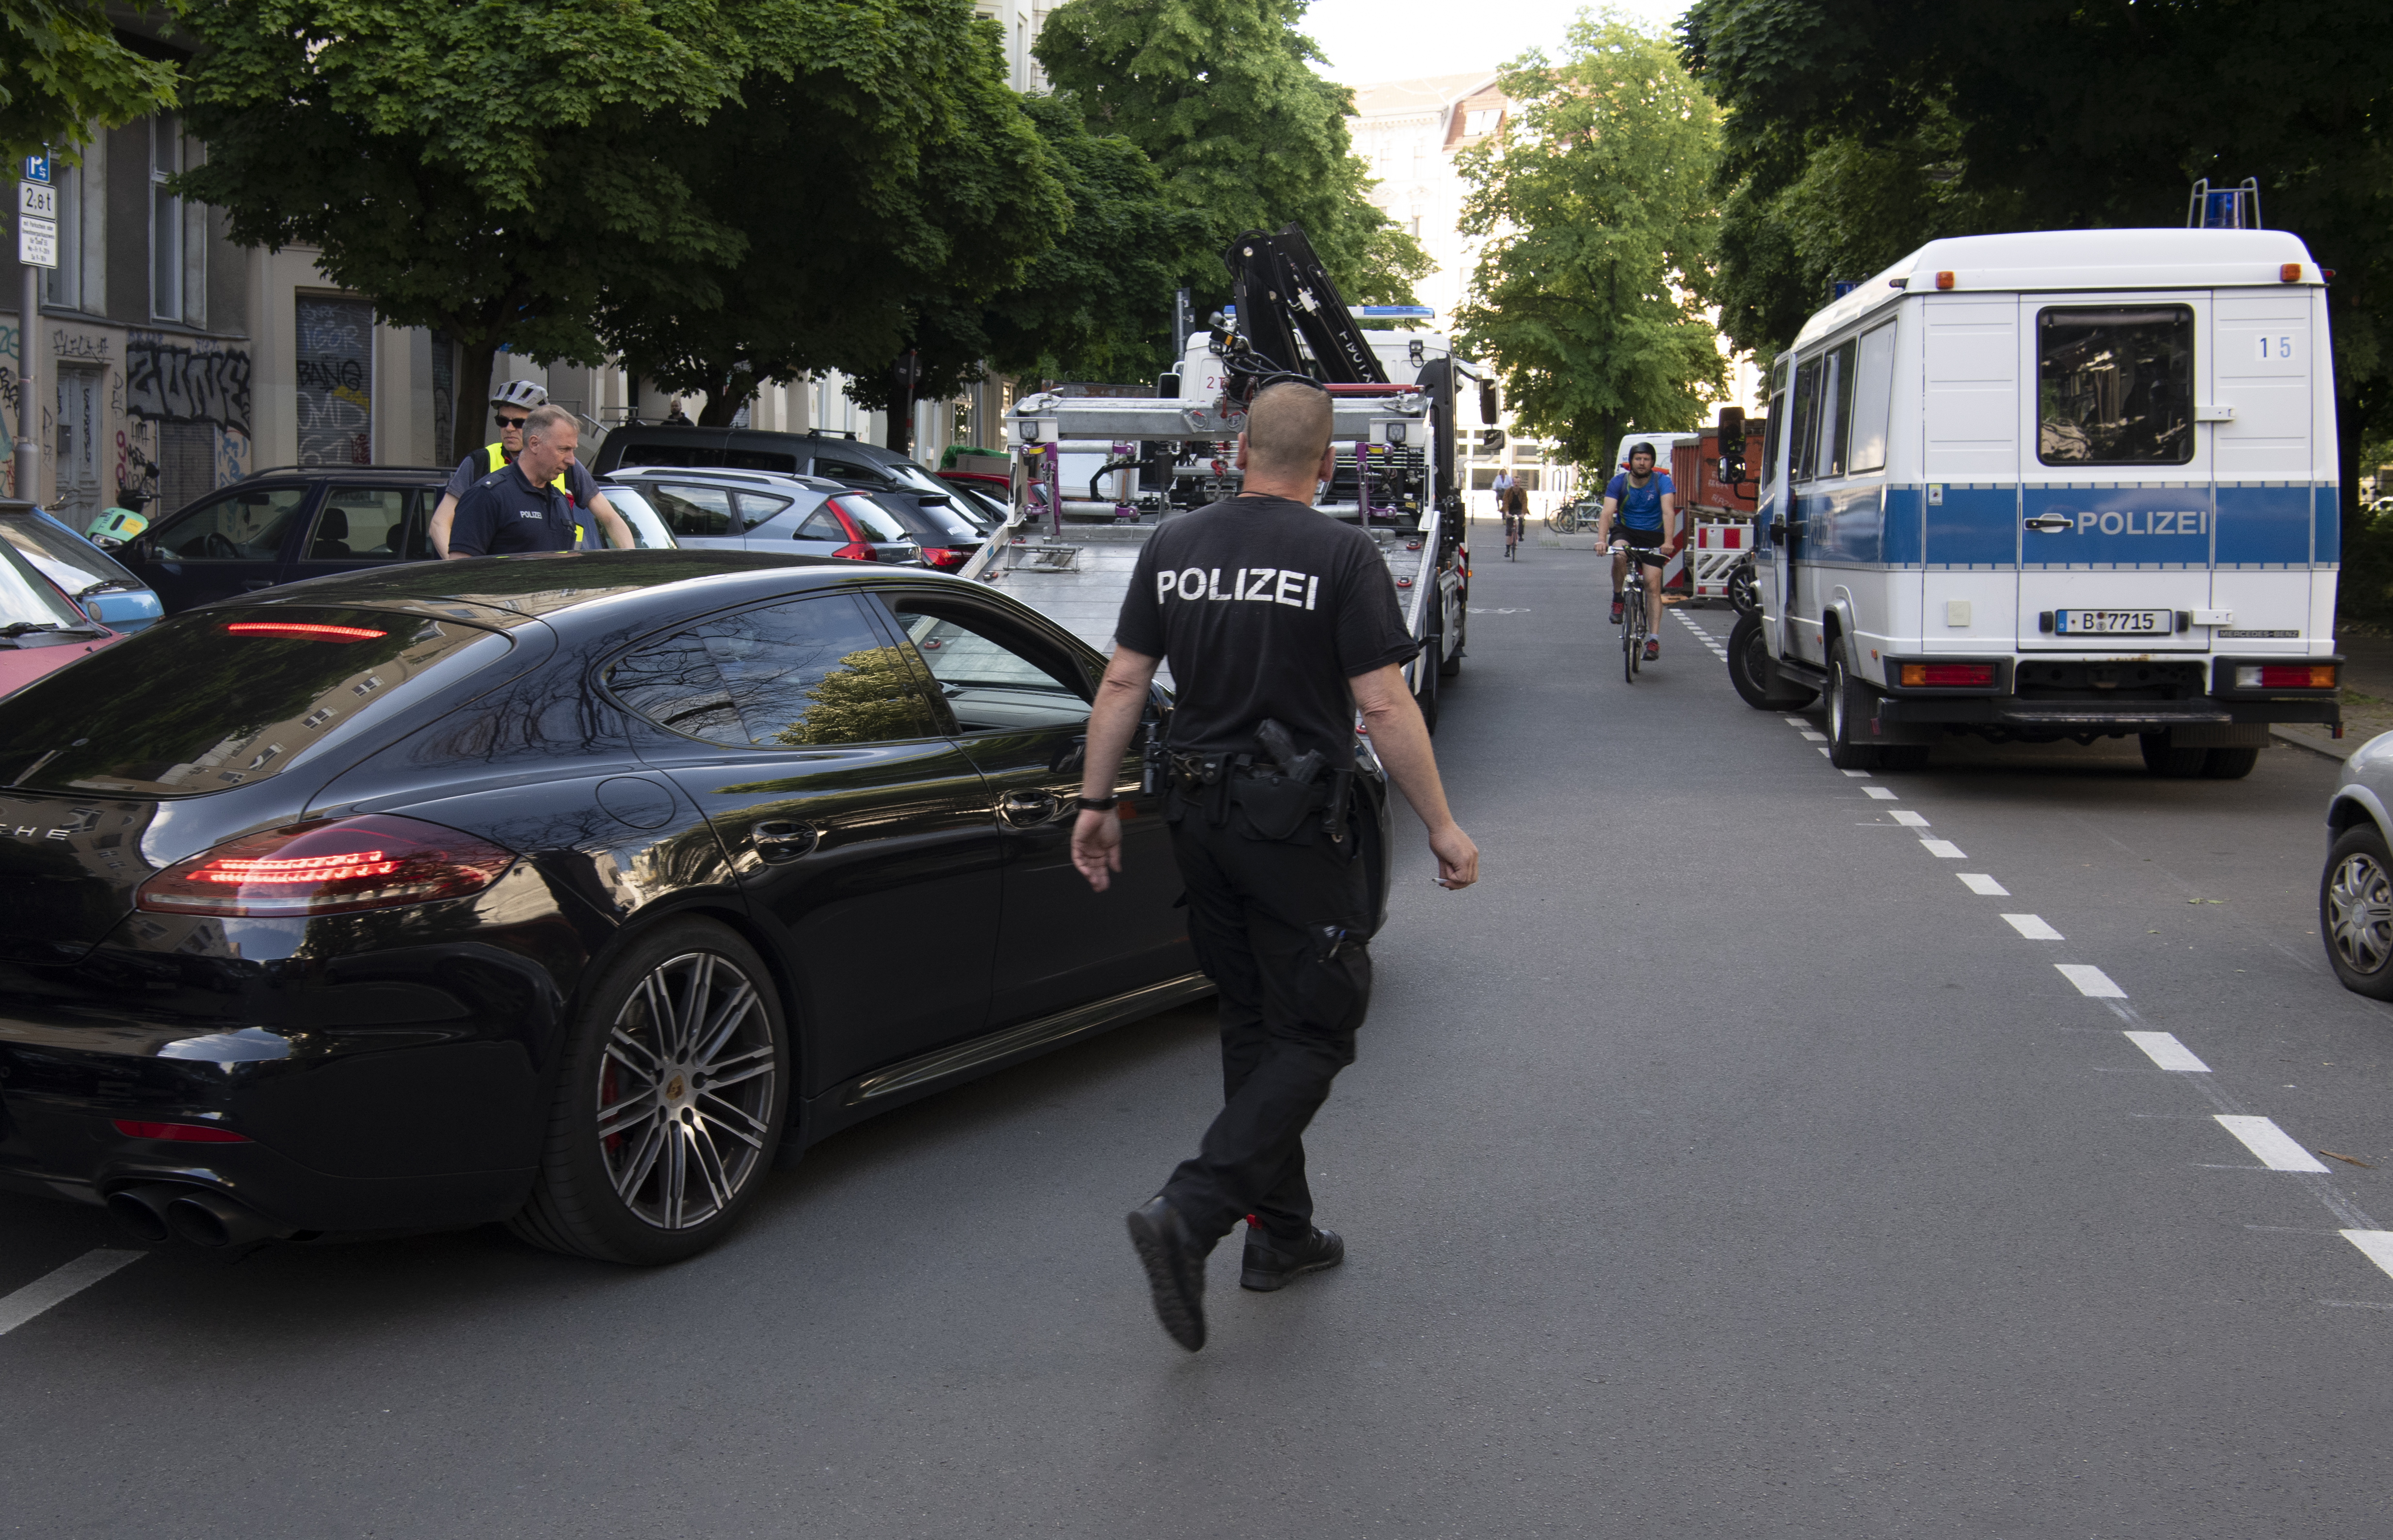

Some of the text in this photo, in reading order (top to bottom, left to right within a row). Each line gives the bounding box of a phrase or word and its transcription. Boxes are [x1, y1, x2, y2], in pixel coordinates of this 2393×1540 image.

[2078, 511, 2206, 535] POLIZEI
[1157, 567, 1319, 610] POLIZEI
[2083, 613, 2094, 629] B
[2108, 613, 2154, 630] 7715
